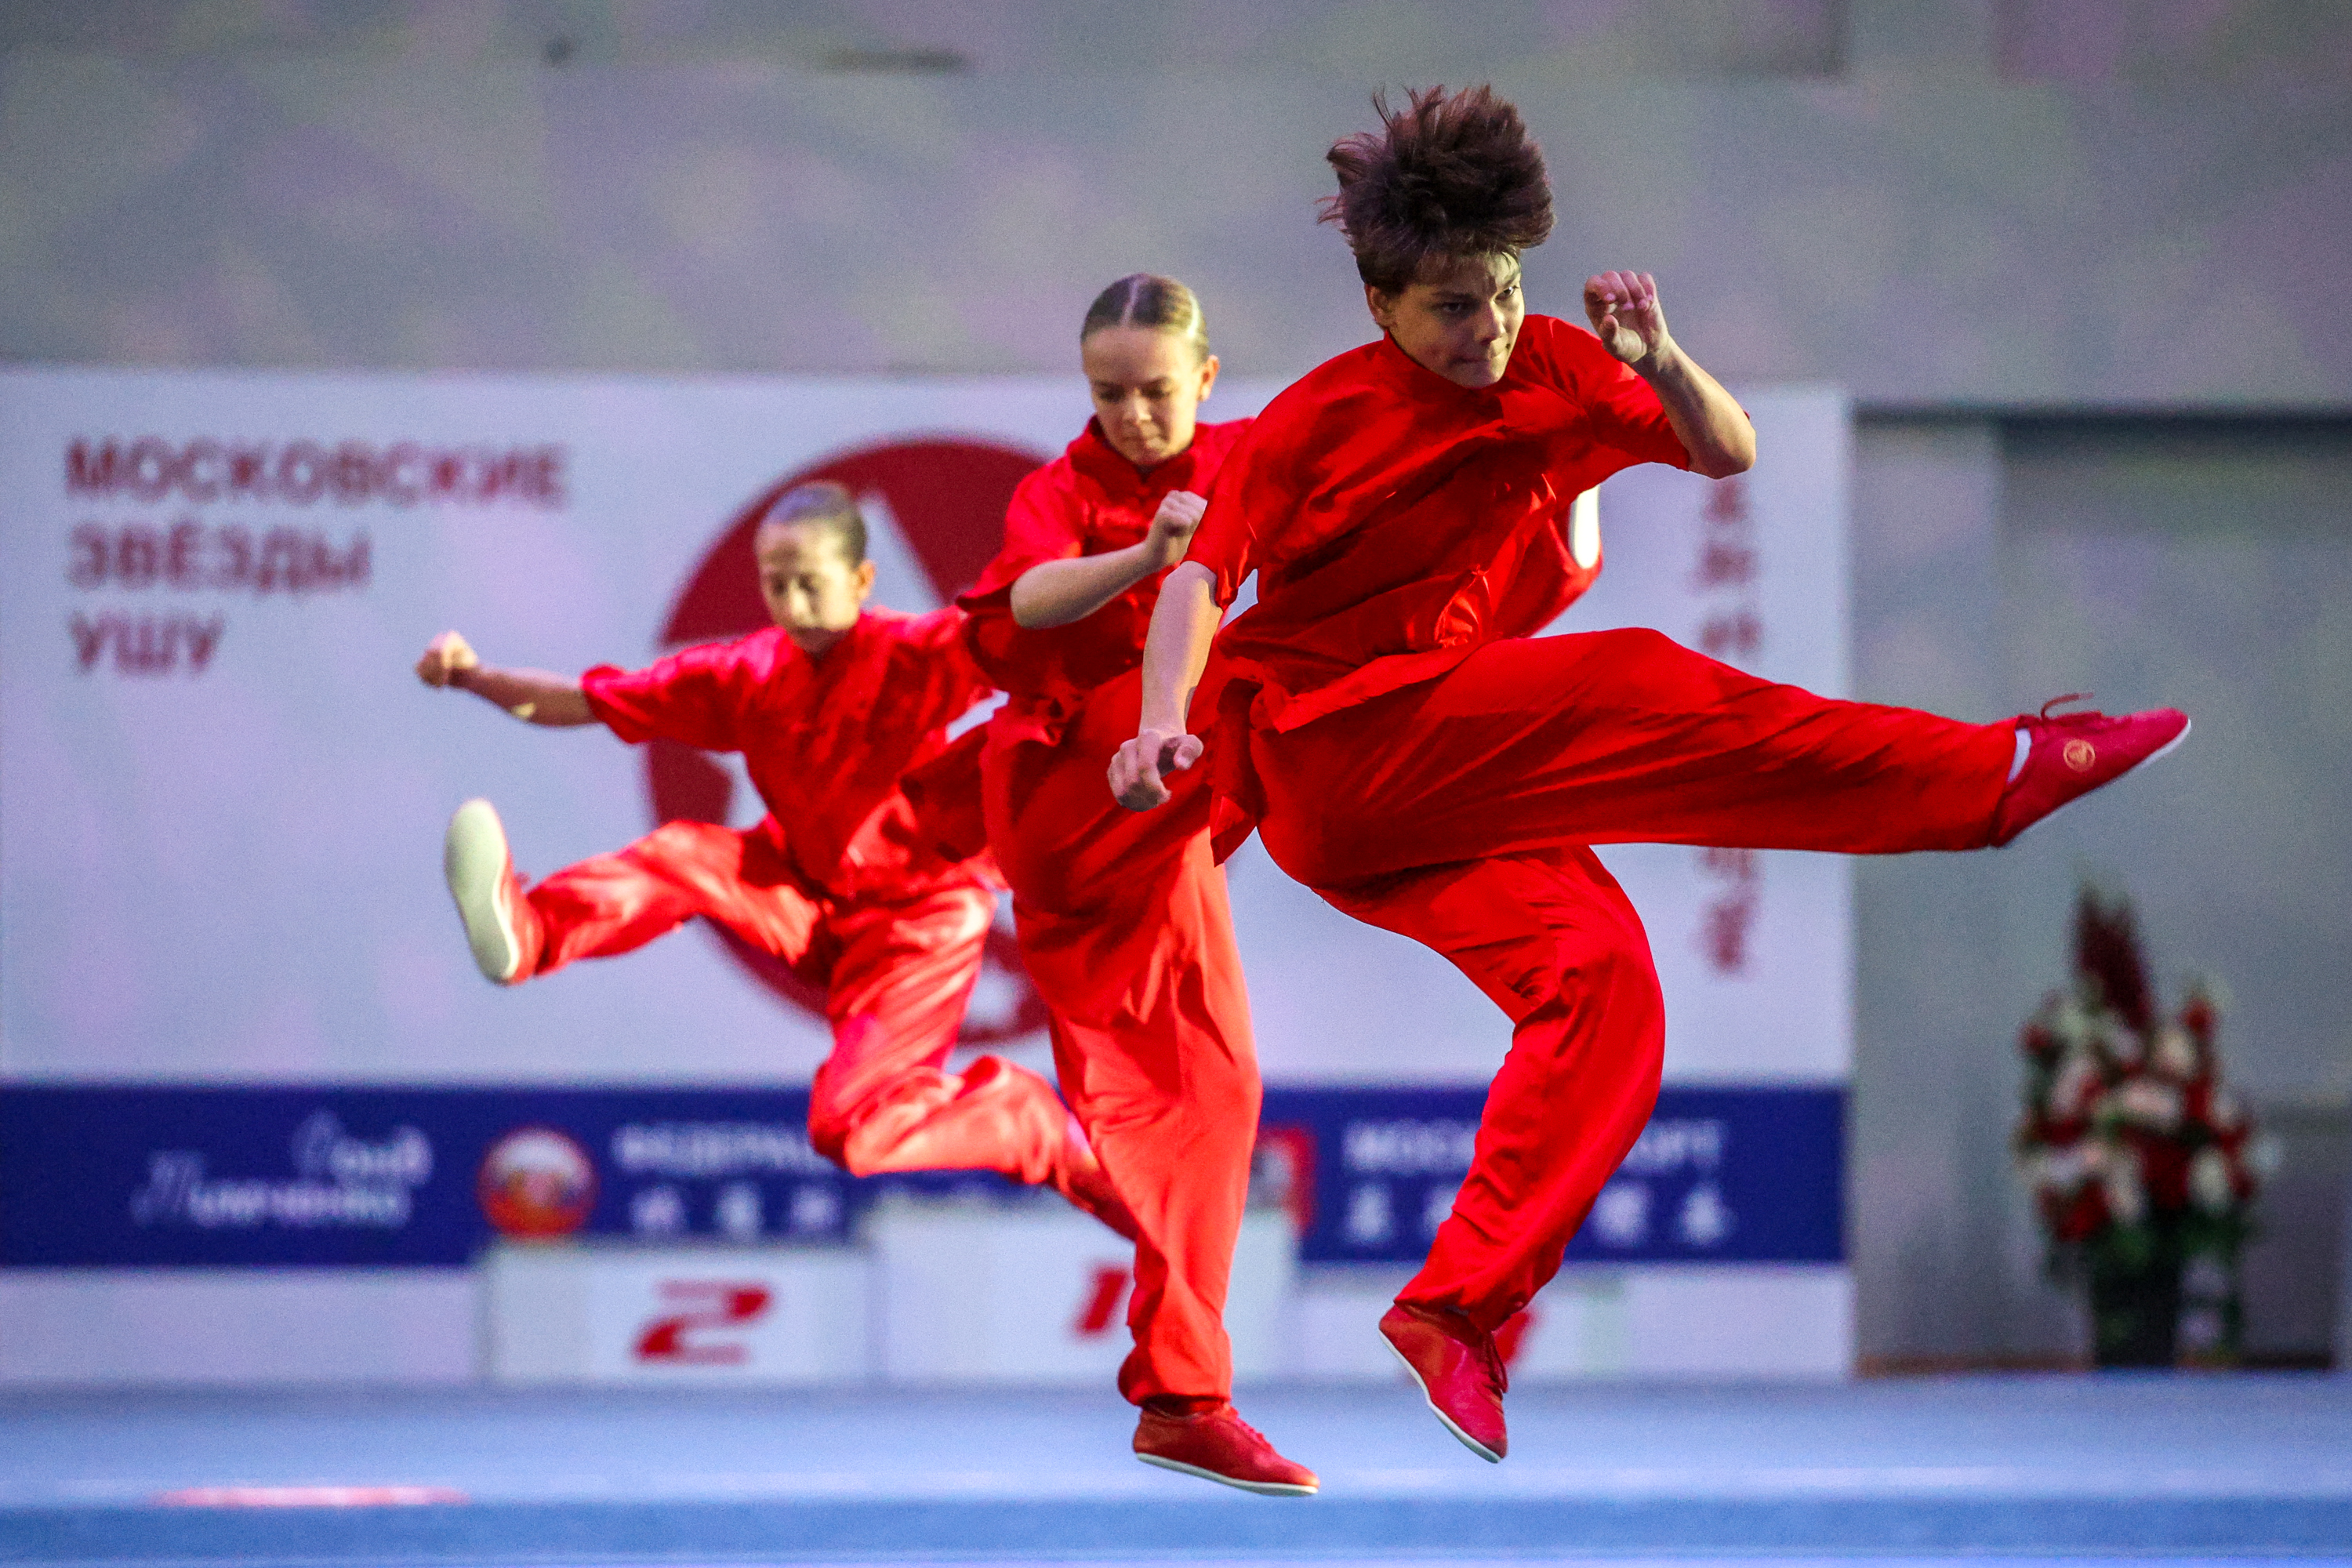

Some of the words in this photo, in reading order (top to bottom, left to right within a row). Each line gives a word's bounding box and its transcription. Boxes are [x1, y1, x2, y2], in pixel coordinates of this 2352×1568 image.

[67, 436, 571, 507] МОСКОВСКИЕ
[67, 518, 372, 599] ЗВЁЗДЫ
[71, 610, 224, 674] УШУ
[635, 1278, 773, 1366] 2
